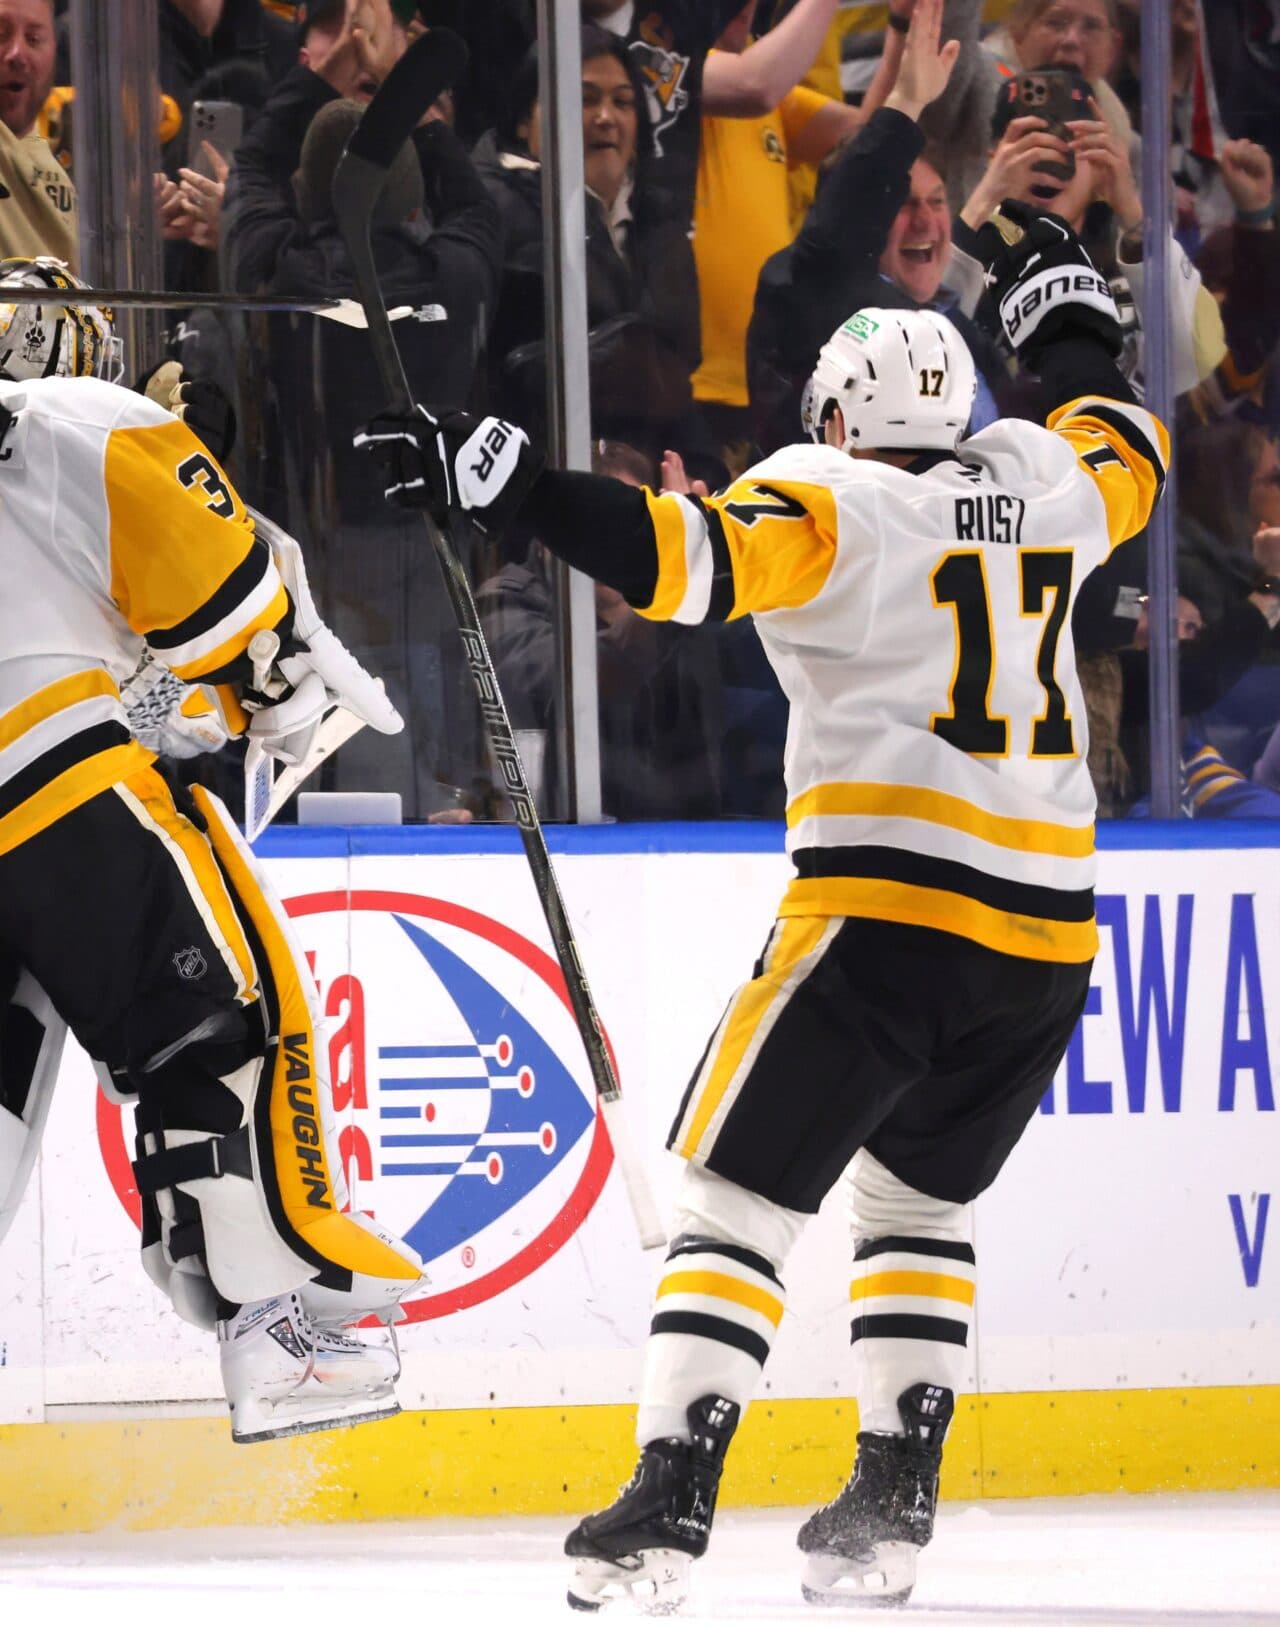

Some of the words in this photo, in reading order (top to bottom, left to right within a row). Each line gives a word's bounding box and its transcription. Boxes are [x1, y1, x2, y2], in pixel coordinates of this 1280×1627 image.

[919, 368, 945, 397] 17
[955, 495, 1026, 544] RUST
[928, 546, 1078, 760] 17
[1042, 894, 1195, 1114] EW
[1217, 893, 1276, 1112] A
[283, 1031, 332, 1211] VAUGHN
[1227, 1193, 1271, 1288] V
